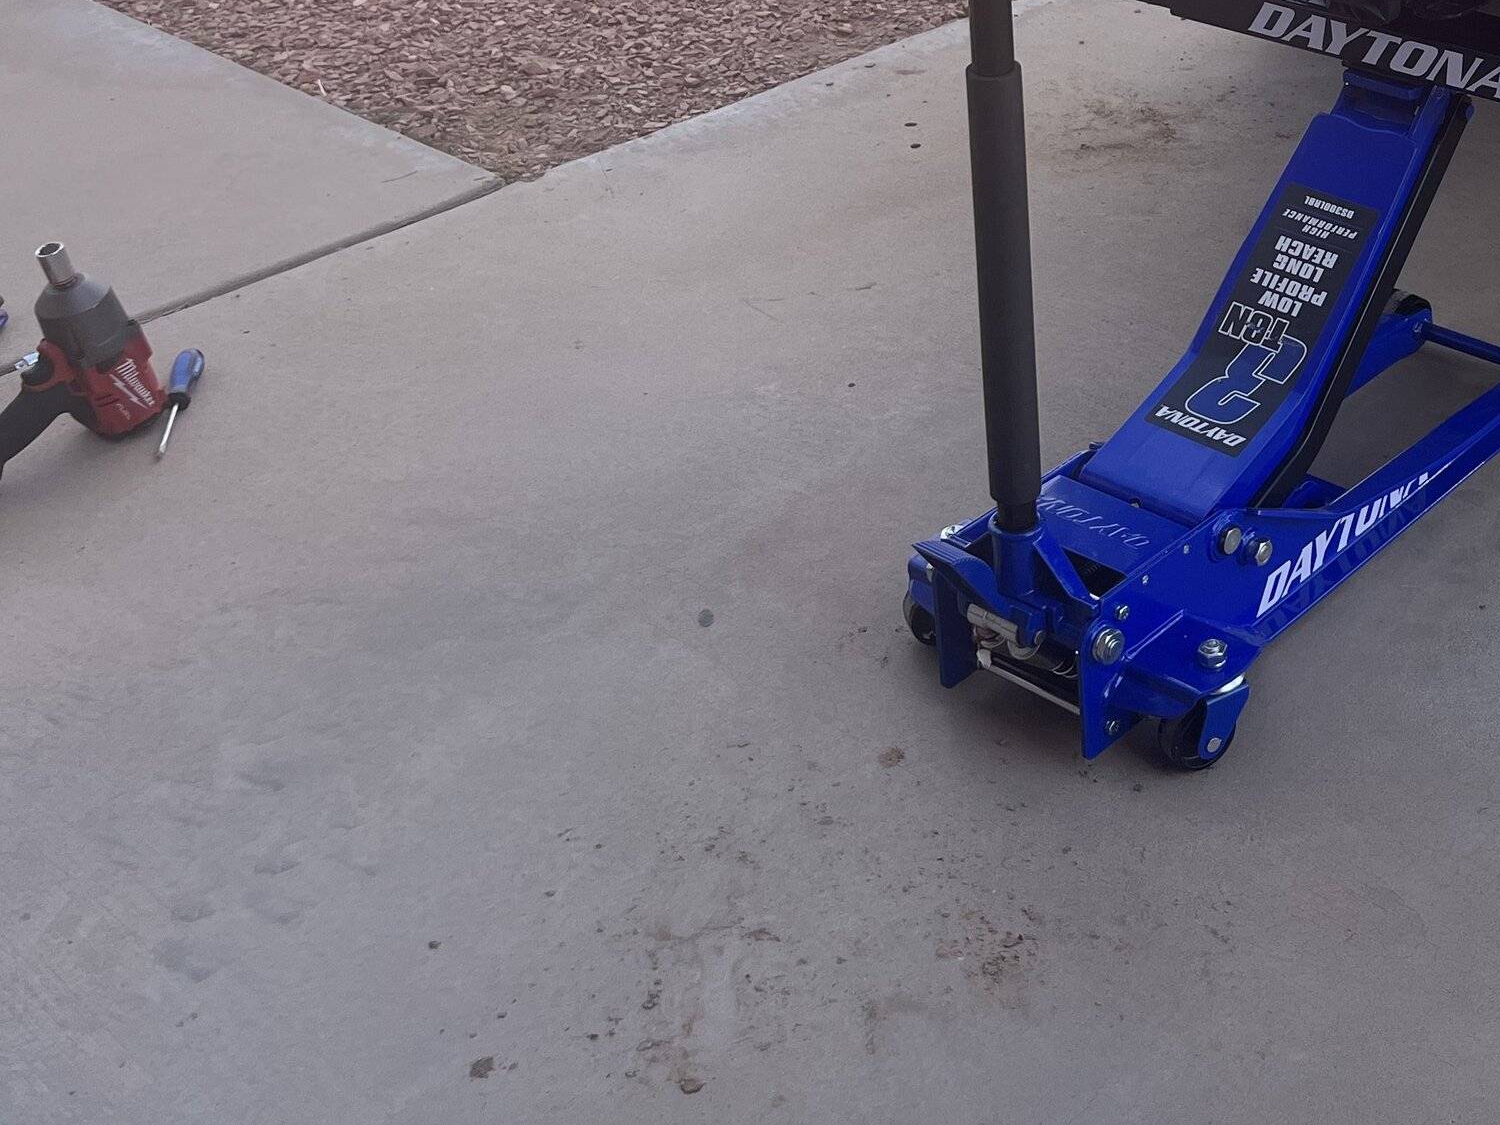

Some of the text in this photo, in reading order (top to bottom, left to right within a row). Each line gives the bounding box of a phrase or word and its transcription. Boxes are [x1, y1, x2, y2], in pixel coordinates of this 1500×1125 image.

[1281, 208, 1358, 239] PERFORMANCE
[1301, 224, 1331, 239] HIGH
[1272, 253, 1324, 283] LONG
[1274, 235, 1339, 269] REACH
[1250, 267, 1328, 307] PROFILE
[1258, 290, 1303, 317] LOW
[1154, 404, 1247, 447] DAYTONA
[1036, 497, 1149, 549] DAYTON
